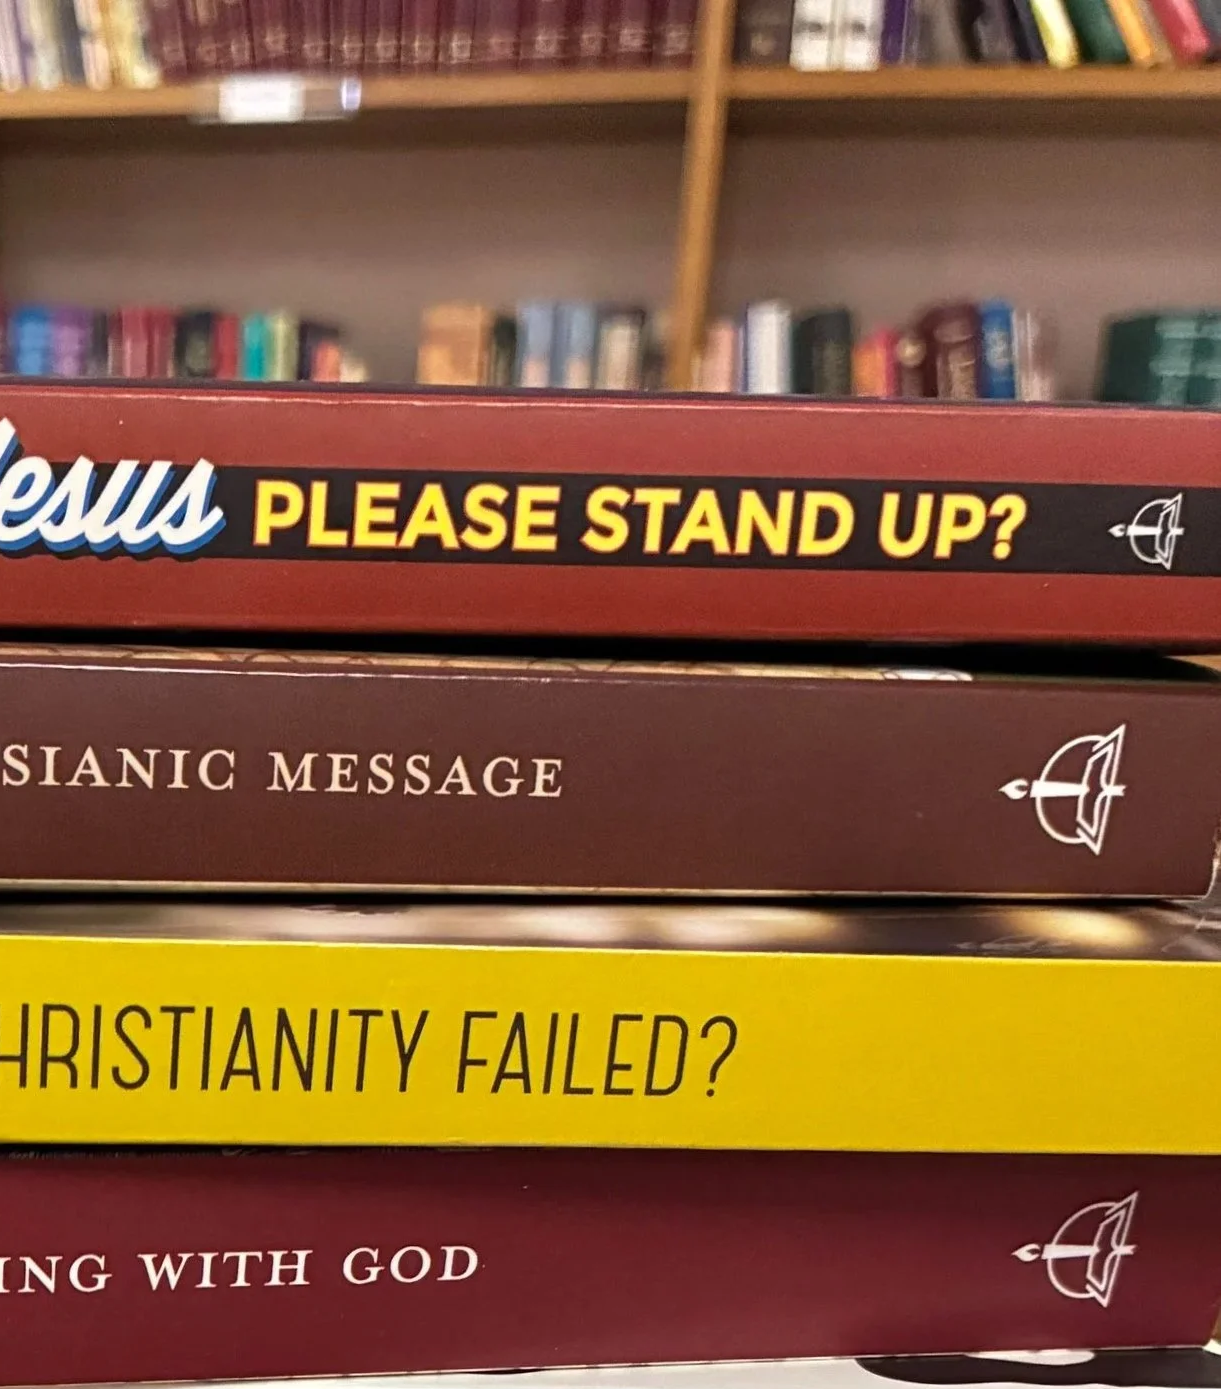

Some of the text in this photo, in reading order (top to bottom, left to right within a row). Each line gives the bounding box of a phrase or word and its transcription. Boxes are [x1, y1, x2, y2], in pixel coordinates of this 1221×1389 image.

[252, 478, 562, 556] PLEASE
[580, 486, 856, 560] STAND
[876, 494, 1030, 562] UP?
[267, 751, 565, 800] MESSAGE
[454, 1010, 739, 1098] FAILED?
[138, 1249, 314, 1290] WITH
[341, 1245, 481, 1286] GOD
